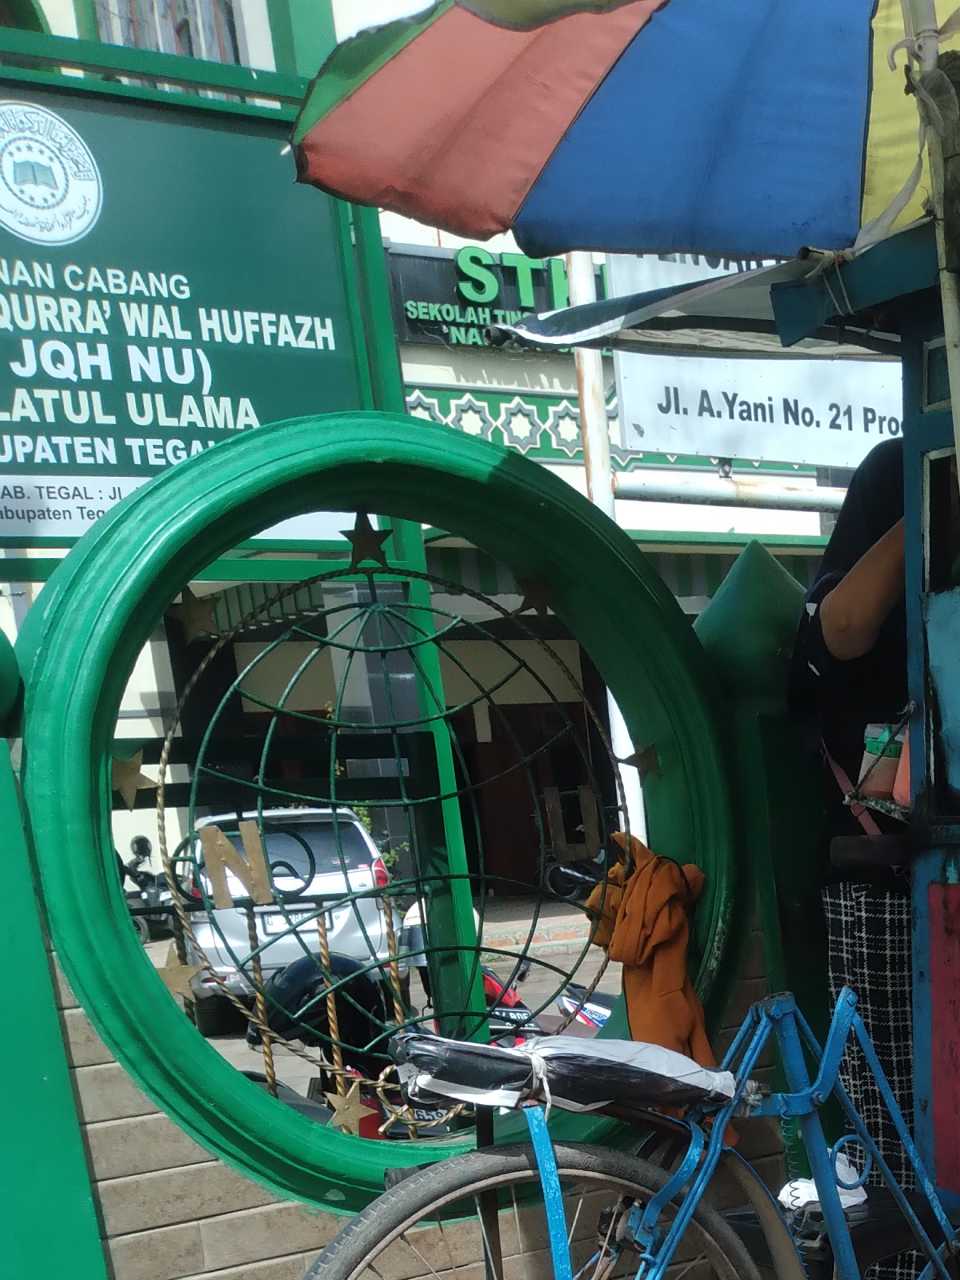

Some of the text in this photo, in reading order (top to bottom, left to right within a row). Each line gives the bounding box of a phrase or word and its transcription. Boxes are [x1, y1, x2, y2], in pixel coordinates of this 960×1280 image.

[64, 265, 190, 299] CABANG
[119, 302, 192, 340] WAL
[199, 308, 336, 350] HUFFAZH
[405, 300, 491, 326] SEKOLAH
[9, 339, 212, 395] JQH NU)
[126, 393, 260, 429] ULAMA
[657, 386, 904, 436] Jl. A.Yani No. 21 Pro
[35, 486, 94, 500] TEGAL
